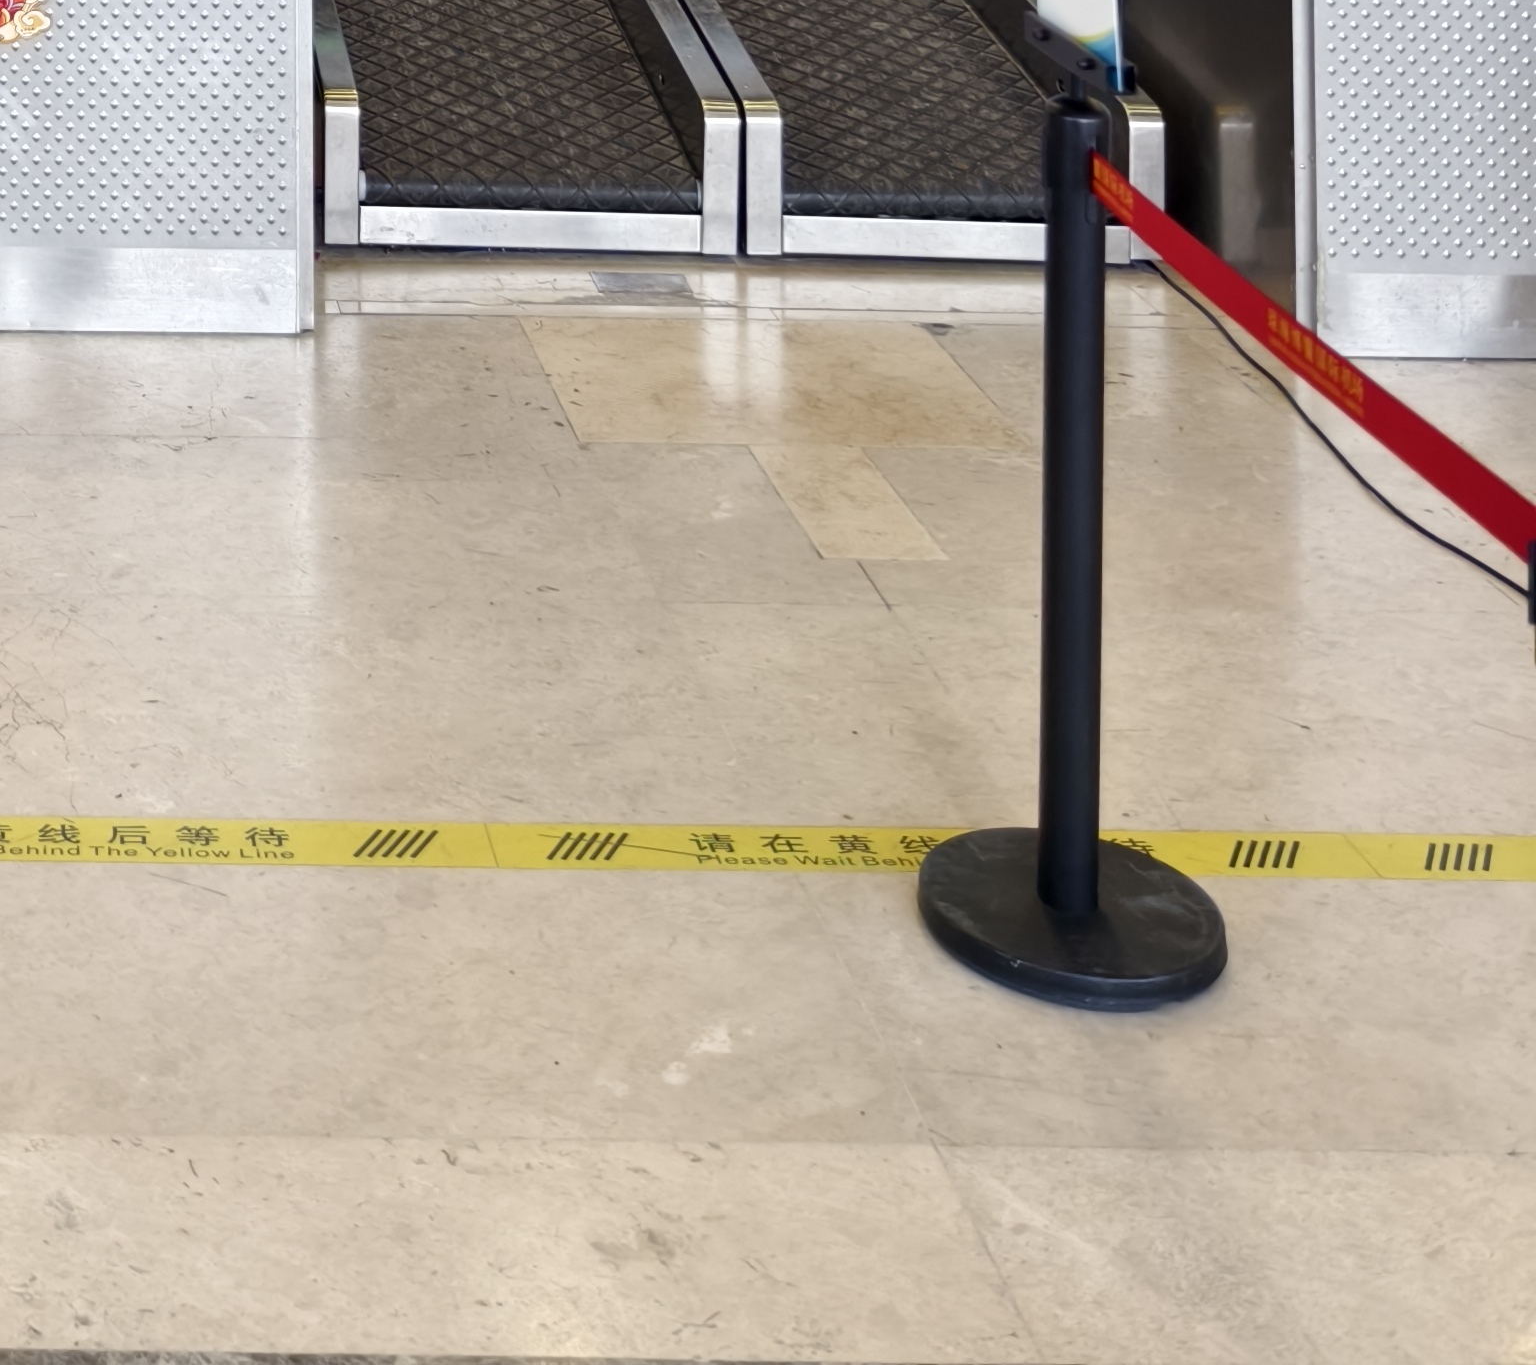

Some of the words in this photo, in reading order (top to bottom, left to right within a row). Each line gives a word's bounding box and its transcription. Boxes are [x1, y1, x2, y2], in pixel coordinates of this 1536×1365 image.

[91, 845, 138, 857] The
[145, 846, 231, 859] Yellow
[239, 847, 295, 859] Line
[696, 854, 789, 866] Please
[797, 854, 856, 867] Wait
